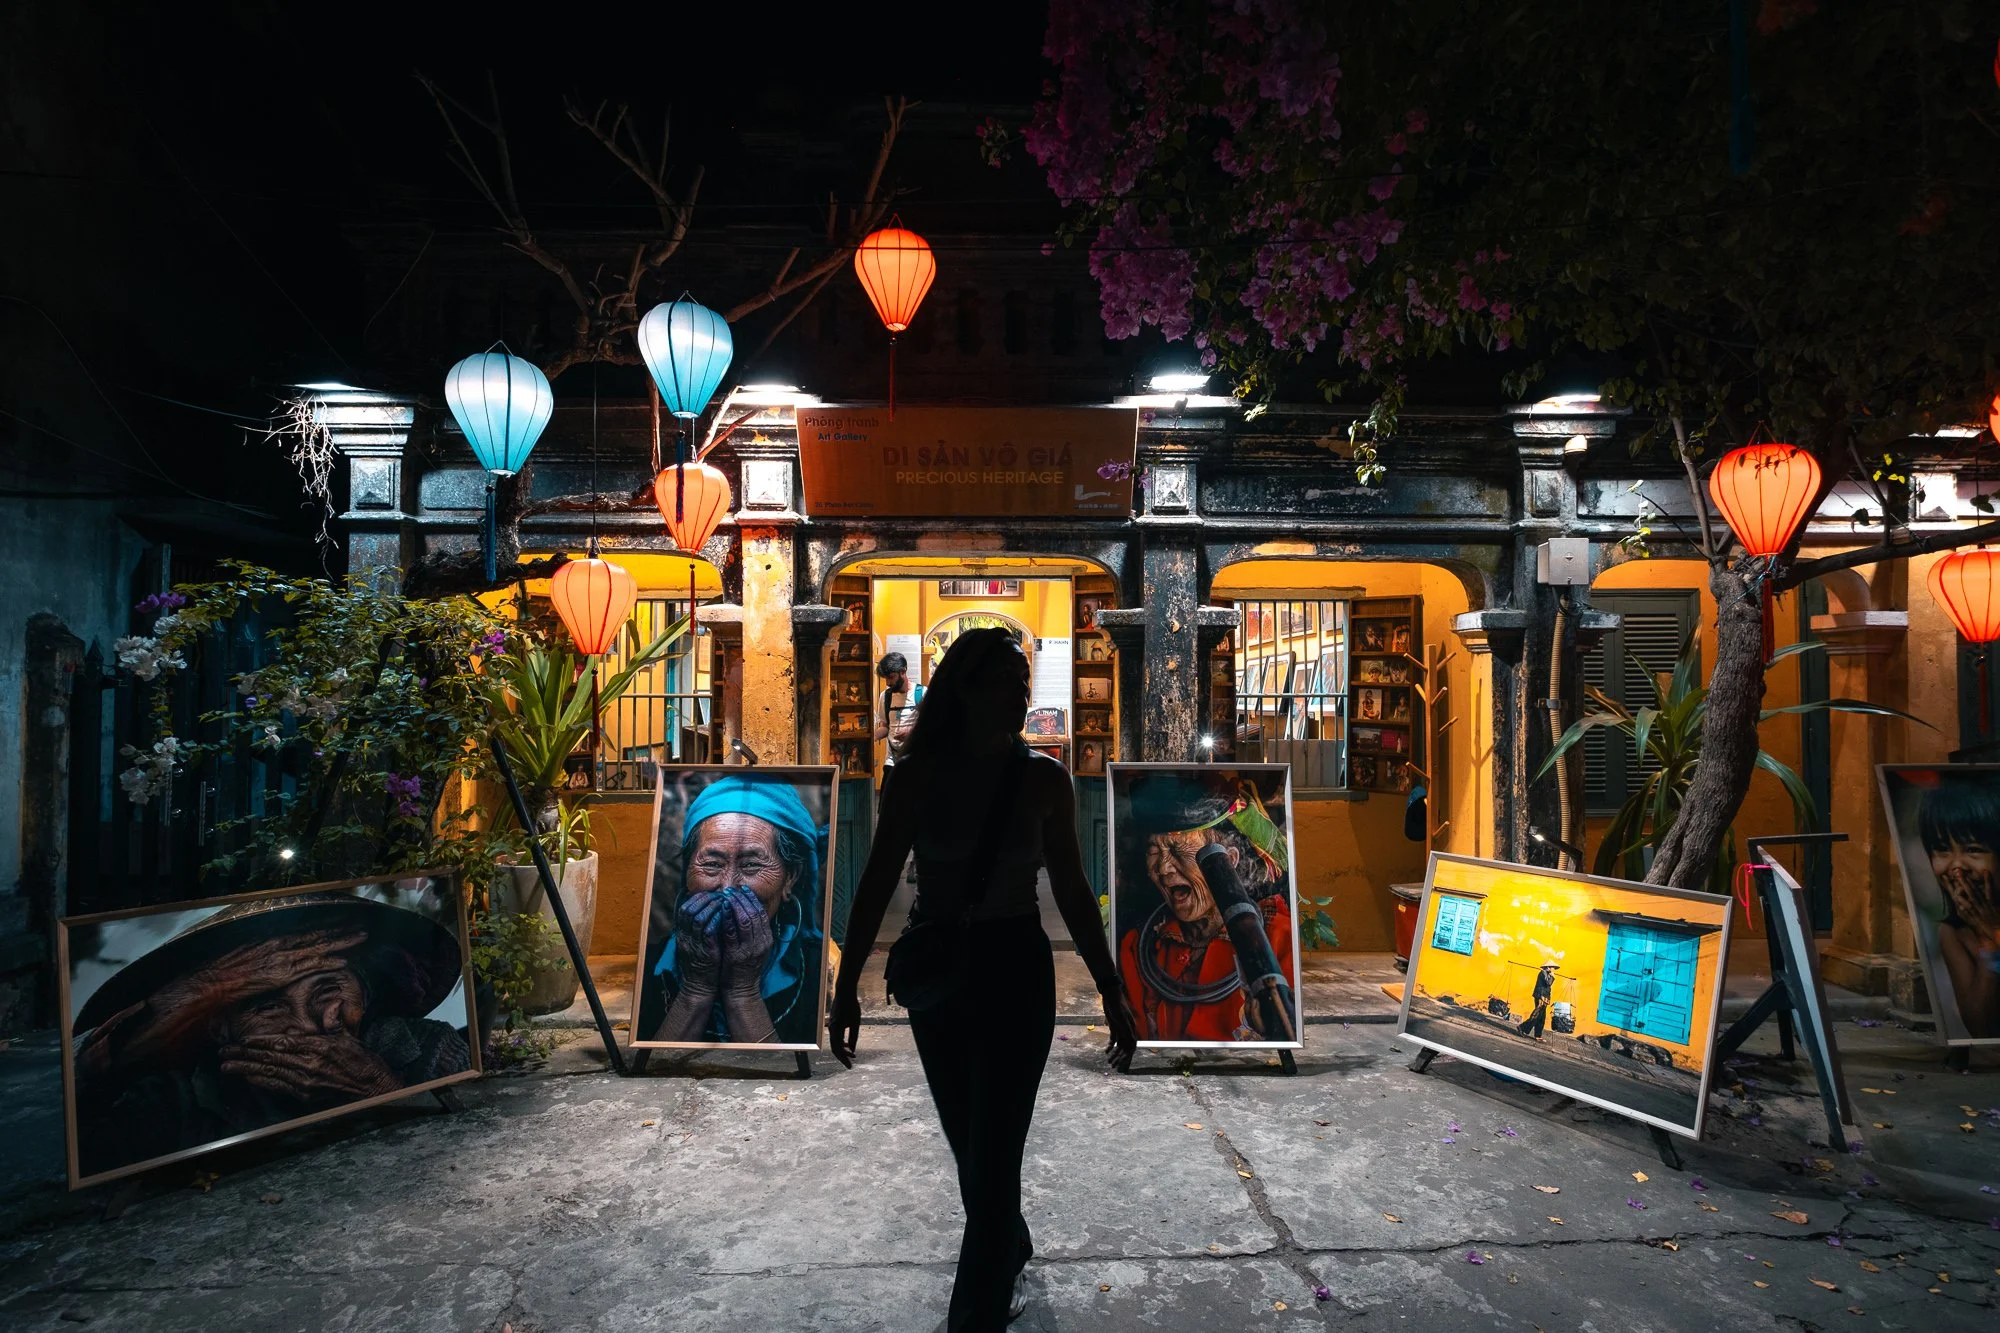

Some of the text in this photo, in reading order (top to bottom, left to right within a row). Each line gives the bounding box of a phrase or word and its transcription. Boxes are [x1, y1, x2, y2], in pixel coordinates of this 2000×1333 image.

[847, 416, 880, 428] tranh
[818, 432, 868, 442] Art Gallery
[883, 446, 909, 466] DI
[1026, 441, 1073, 466] GIÁ
[896, 471, 1064, 485] PRECIOUS HERITAGE
